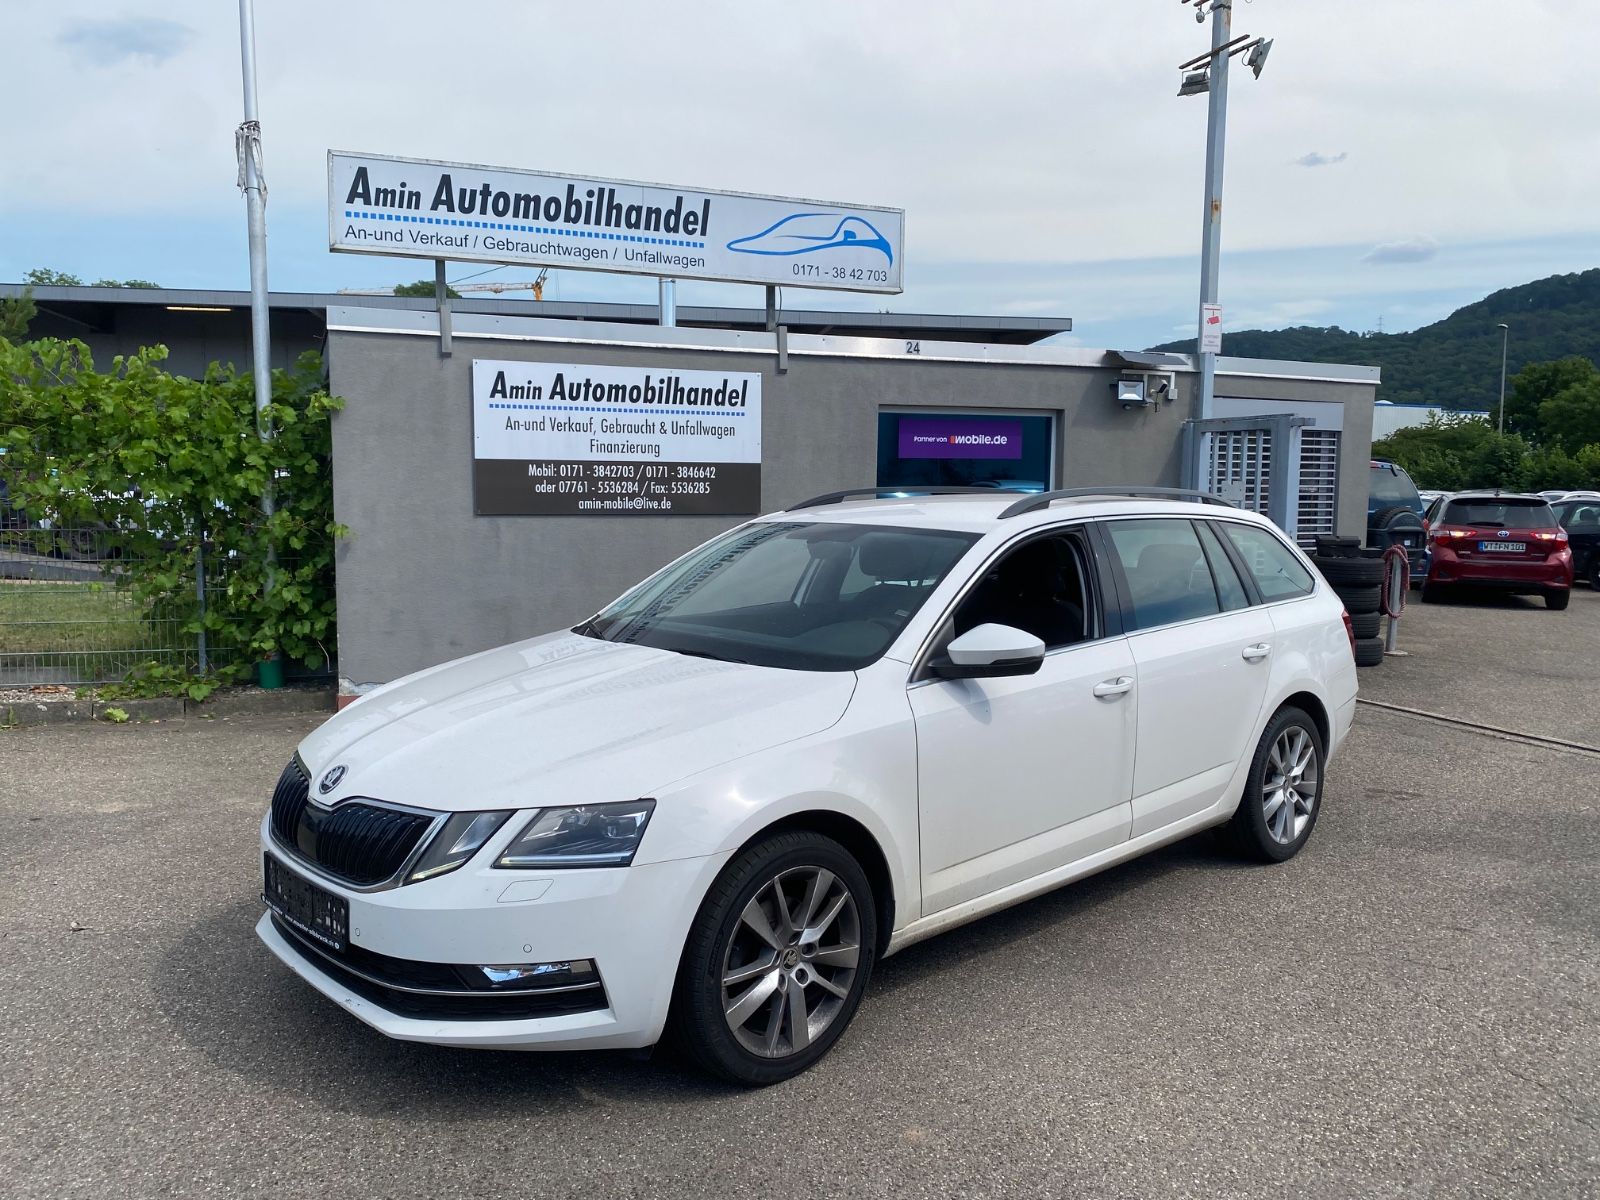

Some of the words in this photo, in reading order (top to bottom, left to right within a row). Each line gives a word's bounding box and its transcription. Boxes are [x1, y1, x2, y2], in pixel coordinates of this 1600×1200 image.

[345, 166, 422, 210] Amin
[430, 173, 711, 237] Automobilhandel
[345, 225, 403, 242] An-und
[408, 230, 469, 248] Verkauf
[473, 236, 478, 248] /
[483, 236, 608, 261] Gebrauchtwagen
[613, 247, 618, 260] /
[624, 248, 705, 268] Unfallwagen
[792, 263, 820, 277] 0171
[832, 266, 846, 279] 38
[849, 268, 864, 280] 42
[867, 270, 888, 282] 703
[906, 342, 921, 354] 24
[489, 371, 543, 400] Amin
[548, 373, 748, 407] Automobilhandel
[505, 415, 546, 432] An-und
[549, 416, 597, 436] Verkauf,
[601, 418, 656, 434] Gebraucht
[659, 421, 668, 435] &
[671, 420, 736, 440] Unfallwagen
[590, 439, 661, 458] Finanzierung
[952, 434, 1008, 445] mobile.de
[528, 463, 558, 478] Mobil:
[560, 464, 584, 478] 0171
[592, 465, 635, 478] 3842703
[636, 465, 645, 481] /
[646, 465, 668, 478] 0171
[677, 466, 717, 479] 3846642
[535, 480, 557, 493] oder
[558, 480, 588, 493] 07761
[597, 481, 639, 494] 5536284
[641, 481, 649, 496] /
[650, 481, 669, 494] Fax:
[671, 482, 711, 494] 5536285
[578, 496, 672, 511] amin-mobile@live.de
